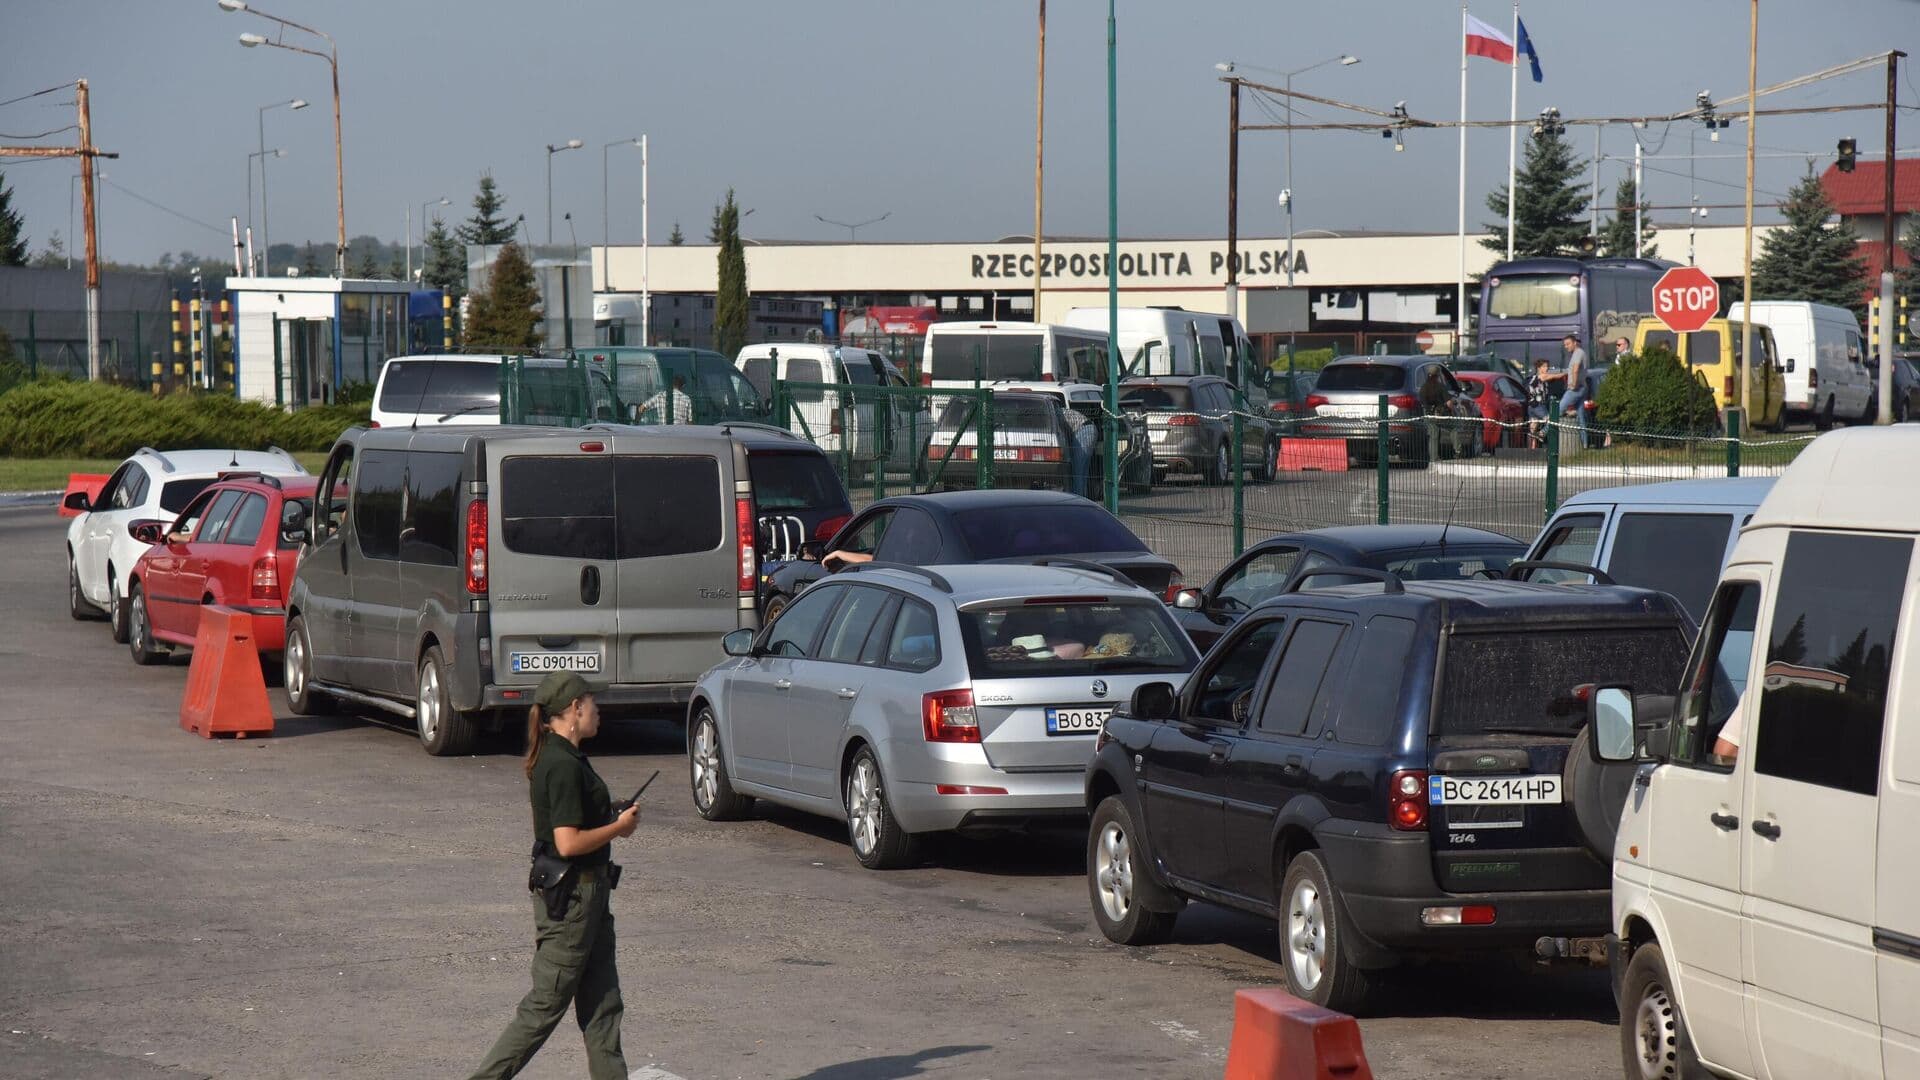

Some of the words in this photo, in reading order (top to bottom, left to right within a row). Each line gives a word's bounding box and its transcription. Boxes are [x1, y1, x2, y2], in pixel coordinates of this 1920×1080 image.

[1210, 250, 1309, 275] POLSKA
[1659, 285, 1715, 313] STOP
[521, 656, 540, 669] BC
[543, 656, 573, 669] 0901
[576, 656, 596, 669] HO
[1058, 712, 1082, 729] BO
[1444, 780, 1473, 800] BC
[1477, 780, 1523, 800] 2614
[1526, 780, 1556, 800] HP
[1448, 833, 1476, 844] Td4
